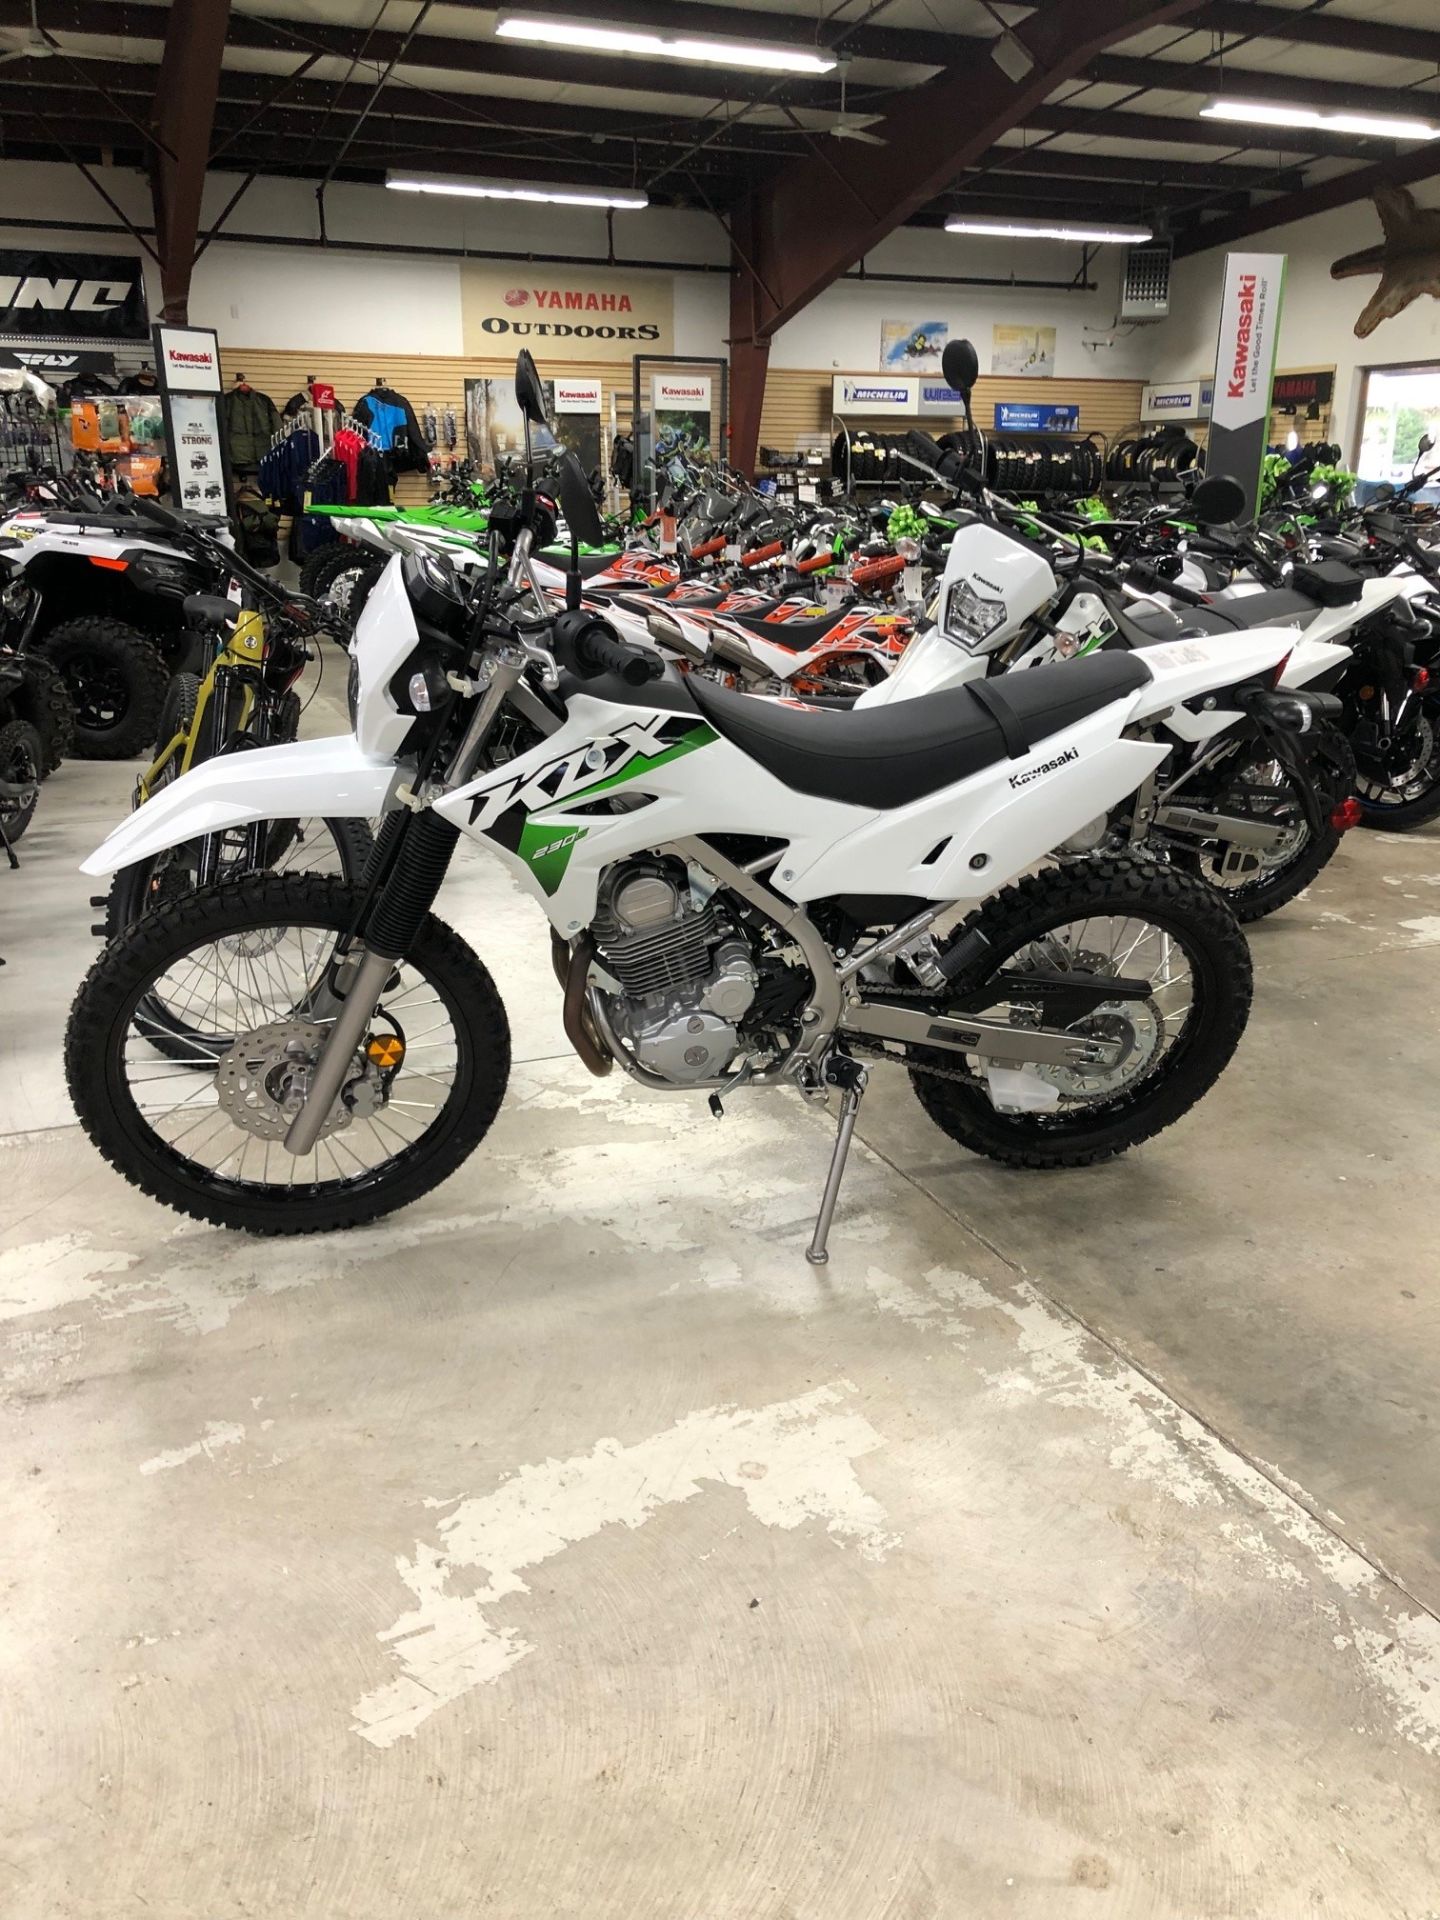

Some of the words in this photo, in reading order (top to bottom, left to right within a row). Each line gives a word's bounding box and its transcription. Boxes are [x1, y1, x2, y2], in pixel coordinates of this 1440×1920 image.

[533, 290, 632, 312] YAMAHA
[1256, 302, 1266, 331] Times
[481, 317, 660, 341] OUTDOORS
[1227, 274, 1257, 398] Kawasaki
[1253, 332, 1262, 358] Good
[169, 350, 212, 363] Kawasaki
[1251, 360, 1259, 375] the
[559, 390, 597, 399] Kawasaki
[661, 386, 704, 396] Kawasaki
[856, 390, 906, 400] MICHELIN
[1156, 396, 1190, 408] MICHELIN
[181, 436, 213, 446] STRONG
[972, 572, 1004, 594] Kawasaki
[1008, 746, 1079, 789] Kawasaki
